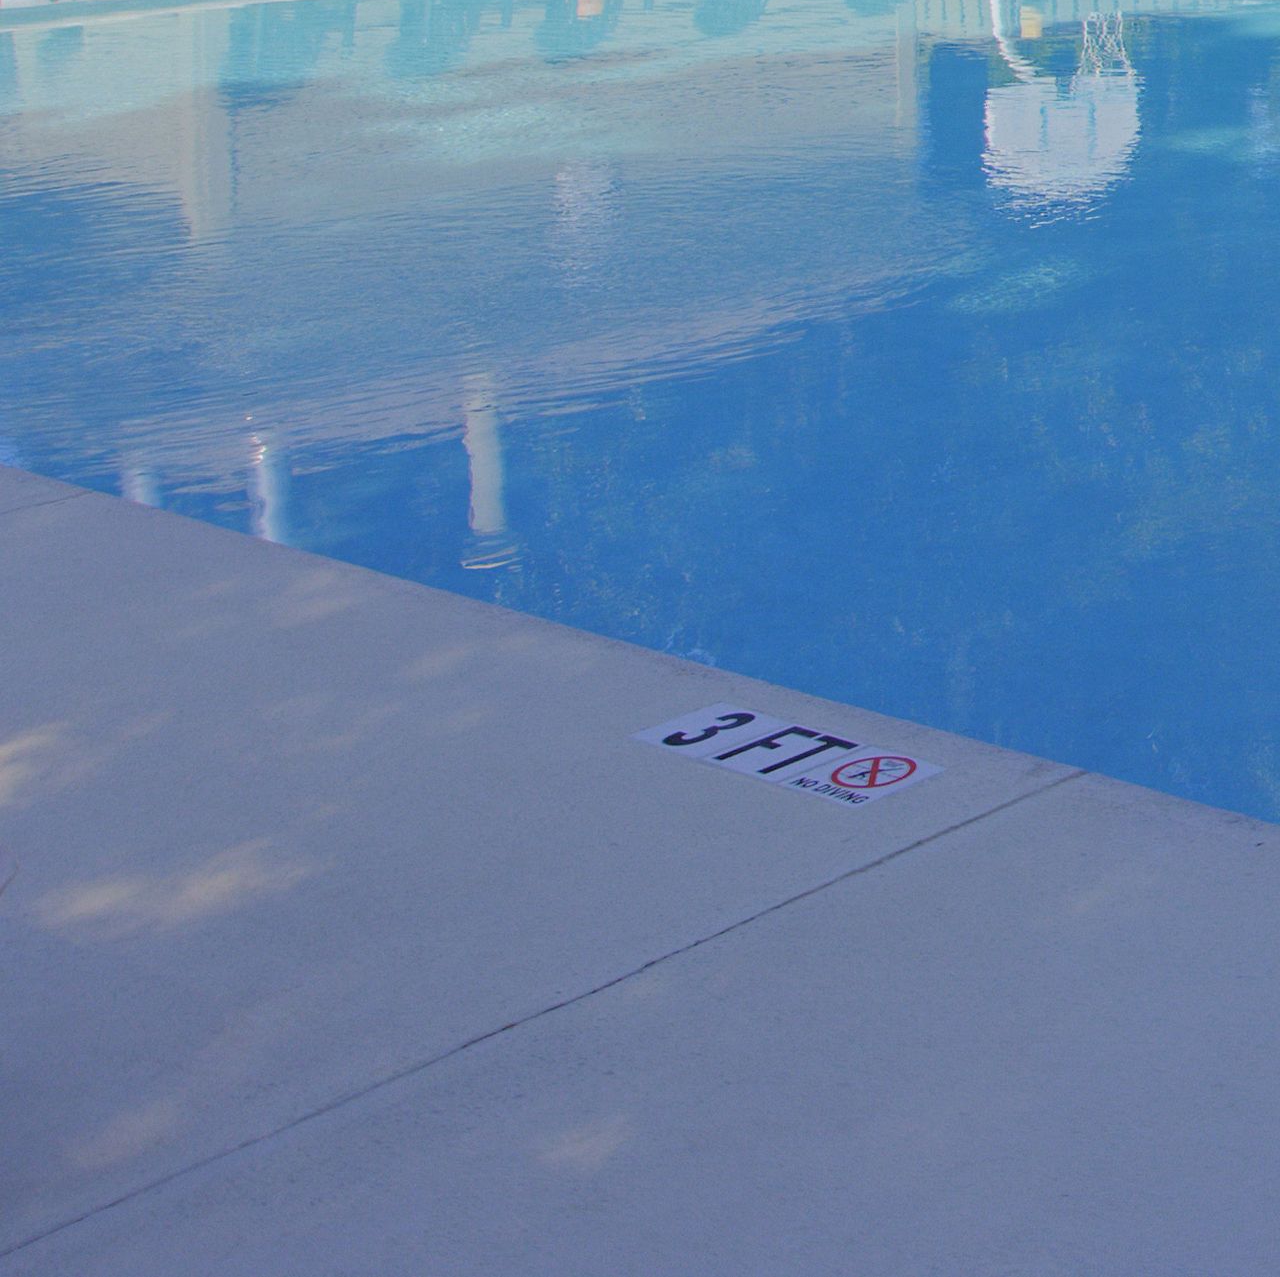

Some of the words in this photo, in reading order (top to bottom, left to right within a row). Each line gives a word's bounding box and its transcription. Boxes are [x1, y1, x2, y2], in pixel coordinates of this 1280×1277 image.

[662, 712, 755, 747] 3
[714, 726, 859, 775] FT
[789, 777, 819, 788] NO
[812, 784, 869, 804] DIVING
